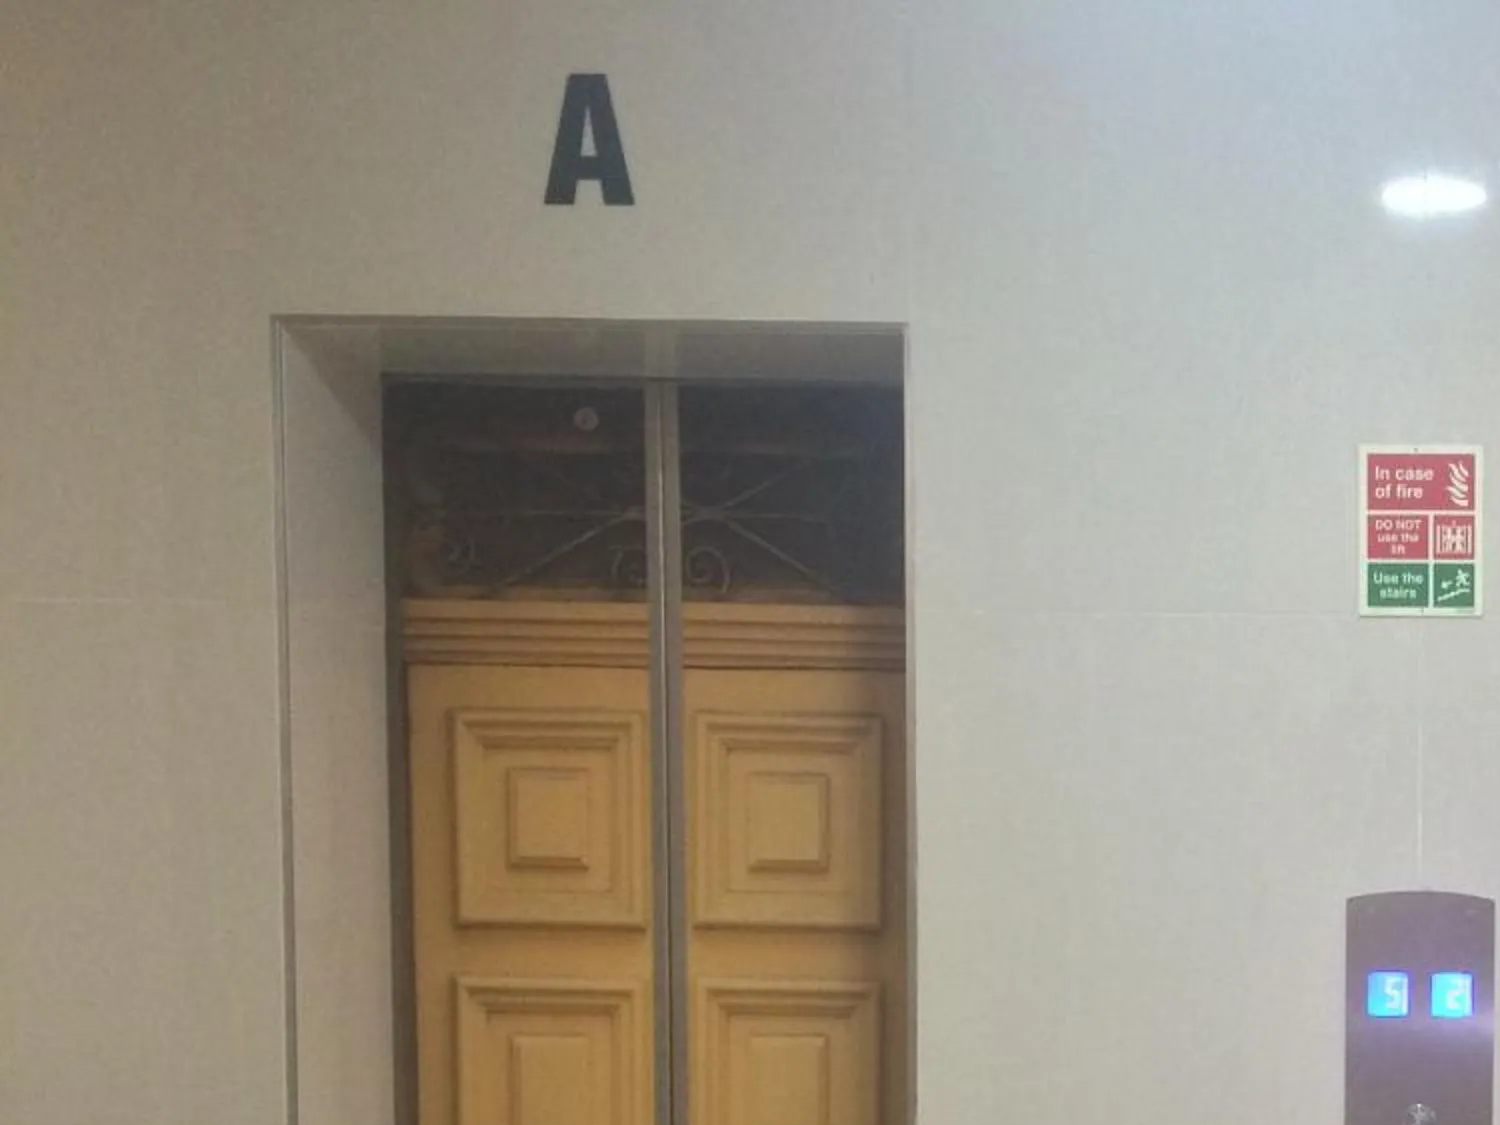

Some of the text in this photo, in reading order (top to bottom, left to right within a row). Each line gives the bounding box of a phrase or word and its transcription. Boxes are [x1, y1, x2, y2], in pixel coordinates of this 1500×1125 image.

[544, 73, 635, 205] A
[1375, 465, 1434, 481] In case
[1375, 484, 1424, 499] of fire
[1375, 519, 1422, 531] DO NOT
[1377, 532, 1420, 543] use the
[1373, 572, 1424, 585] Use the
[1379, 586, 1417, 600] stairs
